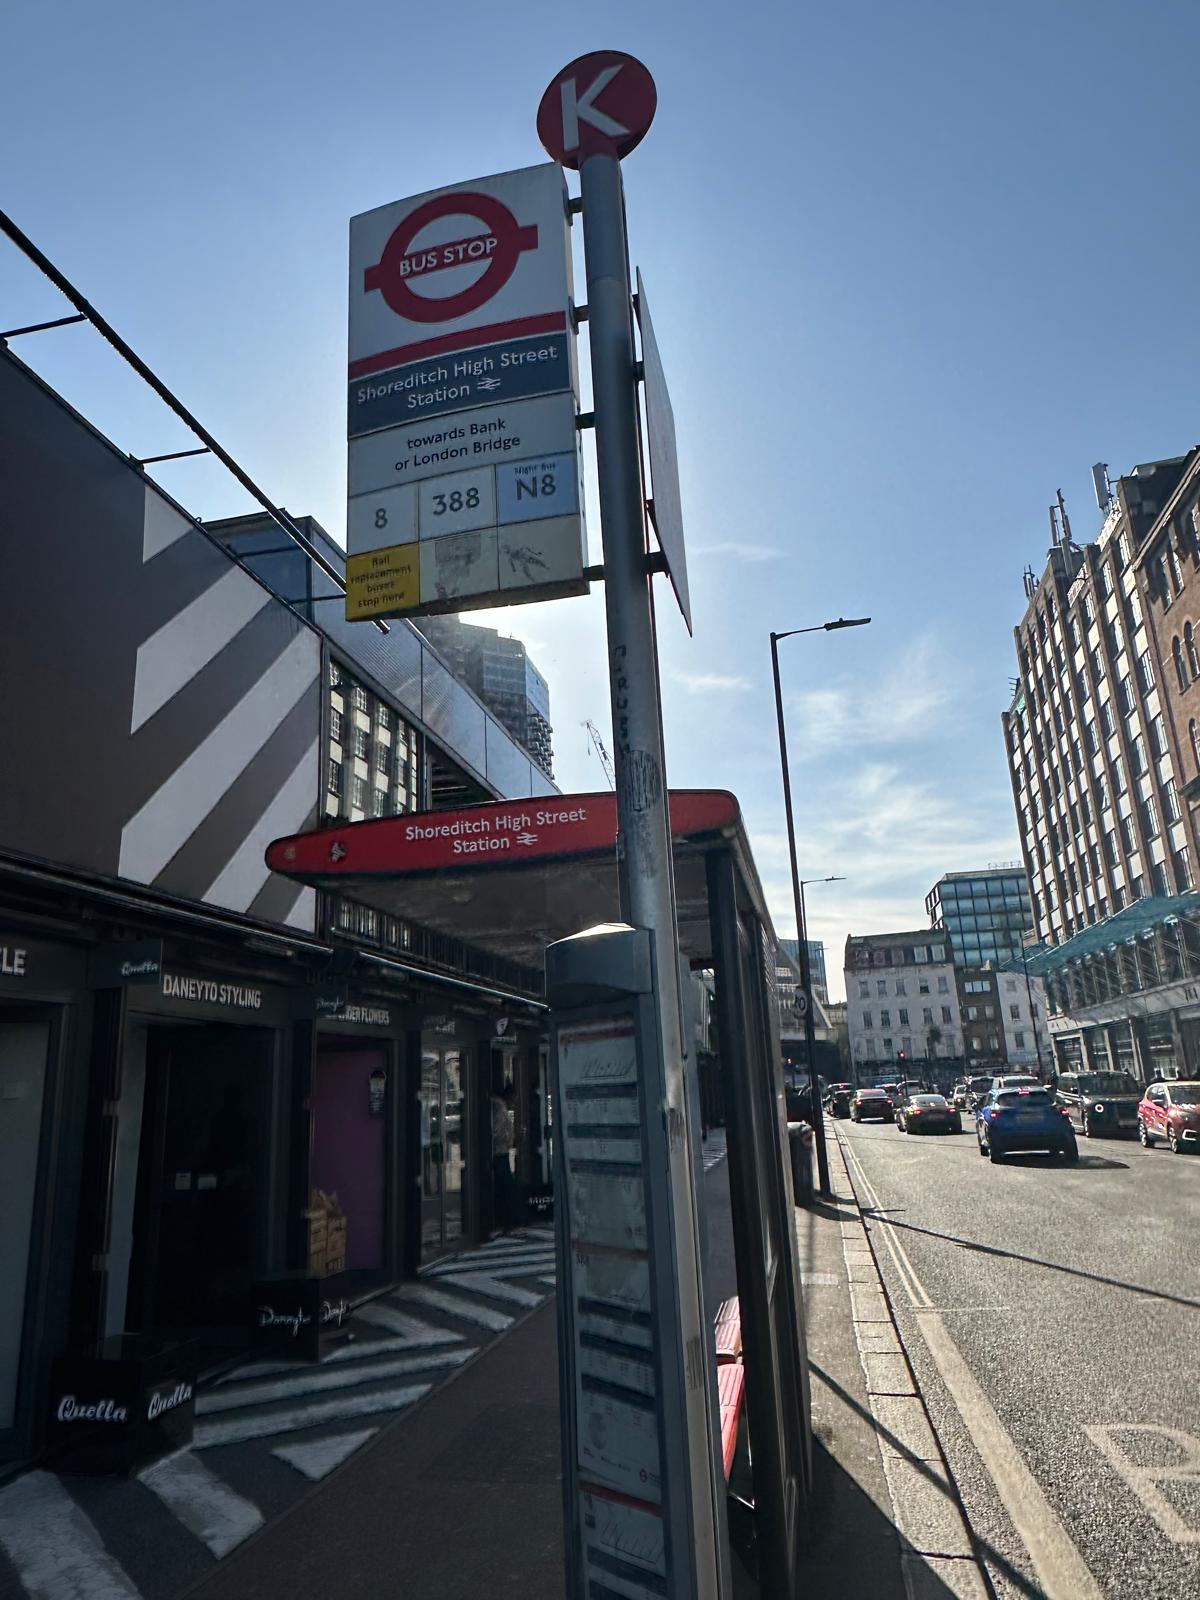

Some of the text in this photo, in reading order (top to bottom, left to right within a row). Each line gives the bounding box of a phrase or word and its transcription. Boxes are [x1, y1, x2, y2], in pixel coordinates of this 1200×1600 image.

[560, 64, 631, 151] K
[399, 237, 498, 277] BUS STOP
[357, 345, 559, 404] Shoreditch High Street
[407, 383, 470, 409] Station
[407, 418, 506, 449] towards Bank
[394, 435, 520, 472] or London Bridge
[432, 487, 480, 516] 388
[516, 474, 556, 501] N8
[374, 507, 389, 529] 8
[358, 597, 380, 609] stop
[405, 807, 588, 841] Shoreditch High Street
[452, 836, 510, 854] Station
[163, 973, 263, 1011] DANEYTO STYLING
[361, 1007, 390, 1026] FLOWERS
[56, 1393, 128, 1424] Quella
[147, 1381, 194, 1421] Quella
